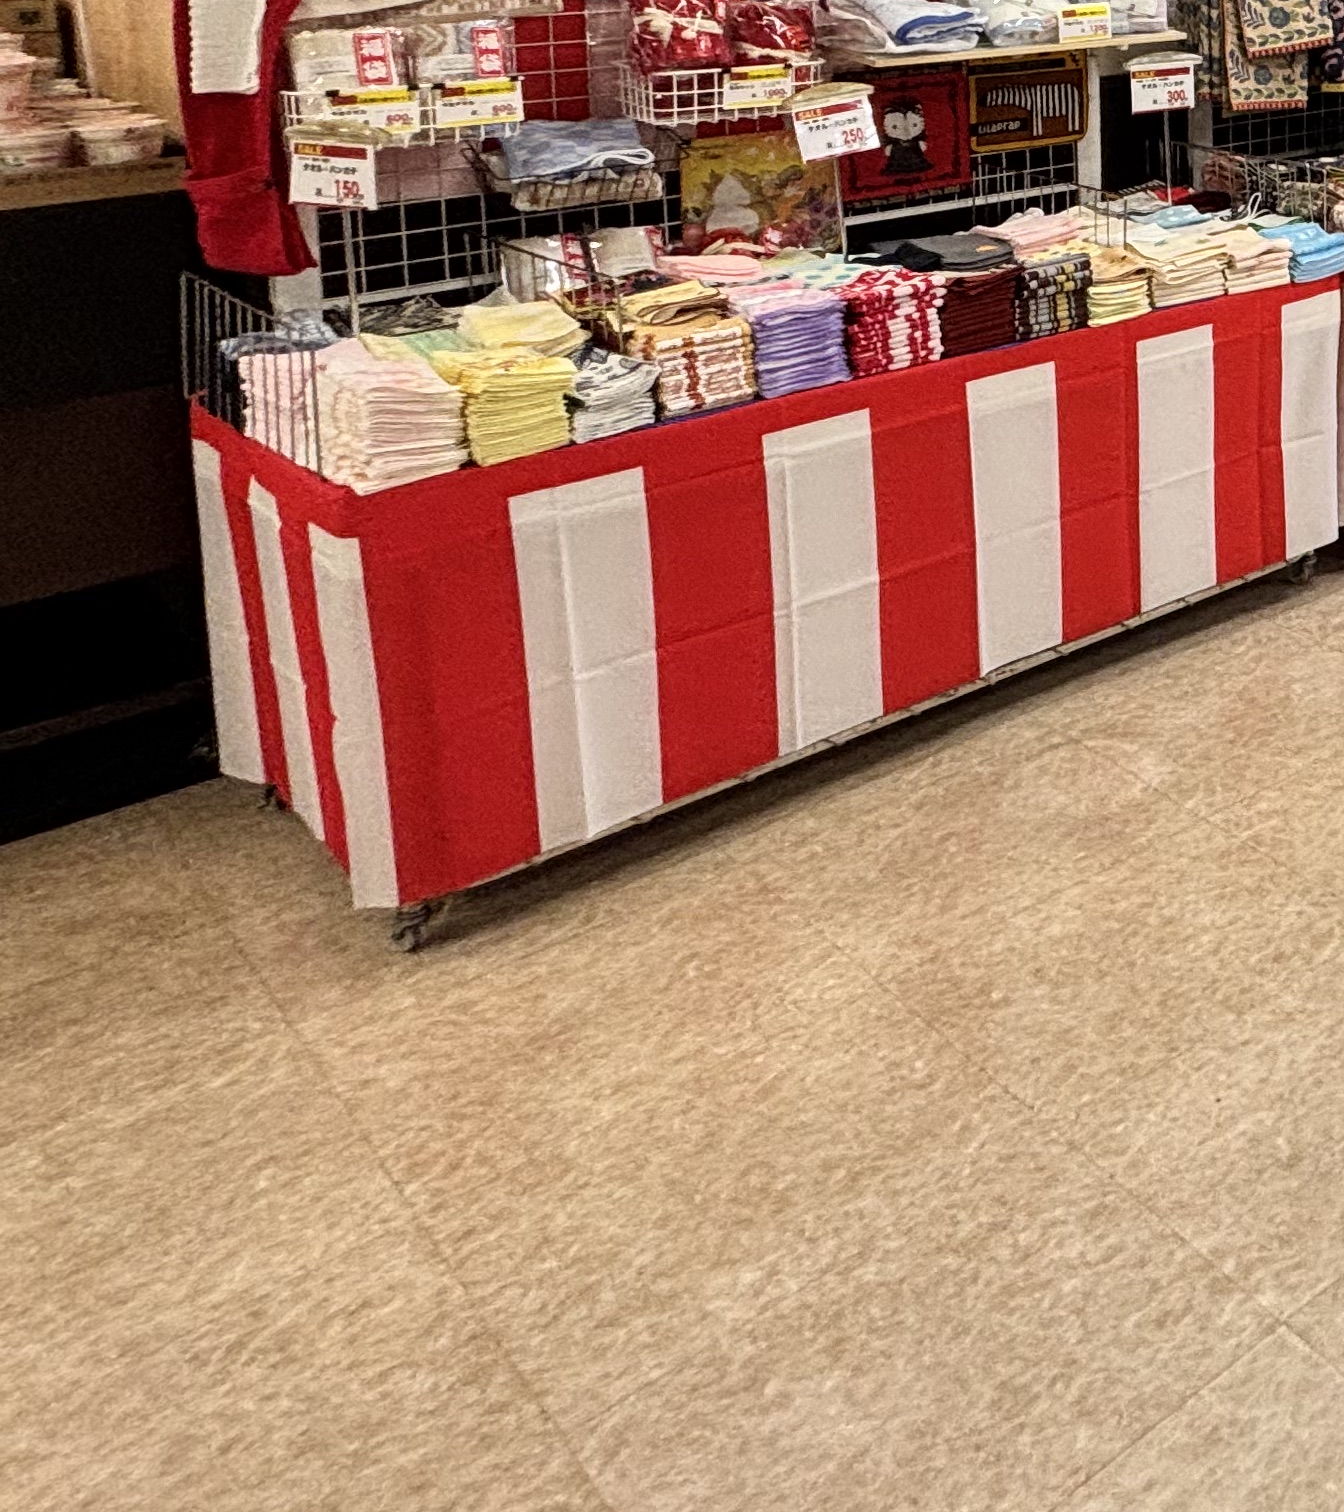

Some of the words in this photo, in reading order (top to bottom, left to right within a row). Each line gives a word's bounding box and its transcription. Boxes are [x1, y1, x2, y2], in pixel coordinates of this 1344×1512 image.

[1167, 90, 1186, 104] 300
[842, 127, 864, 146] 250
[335, 180, 360, 199] 150
